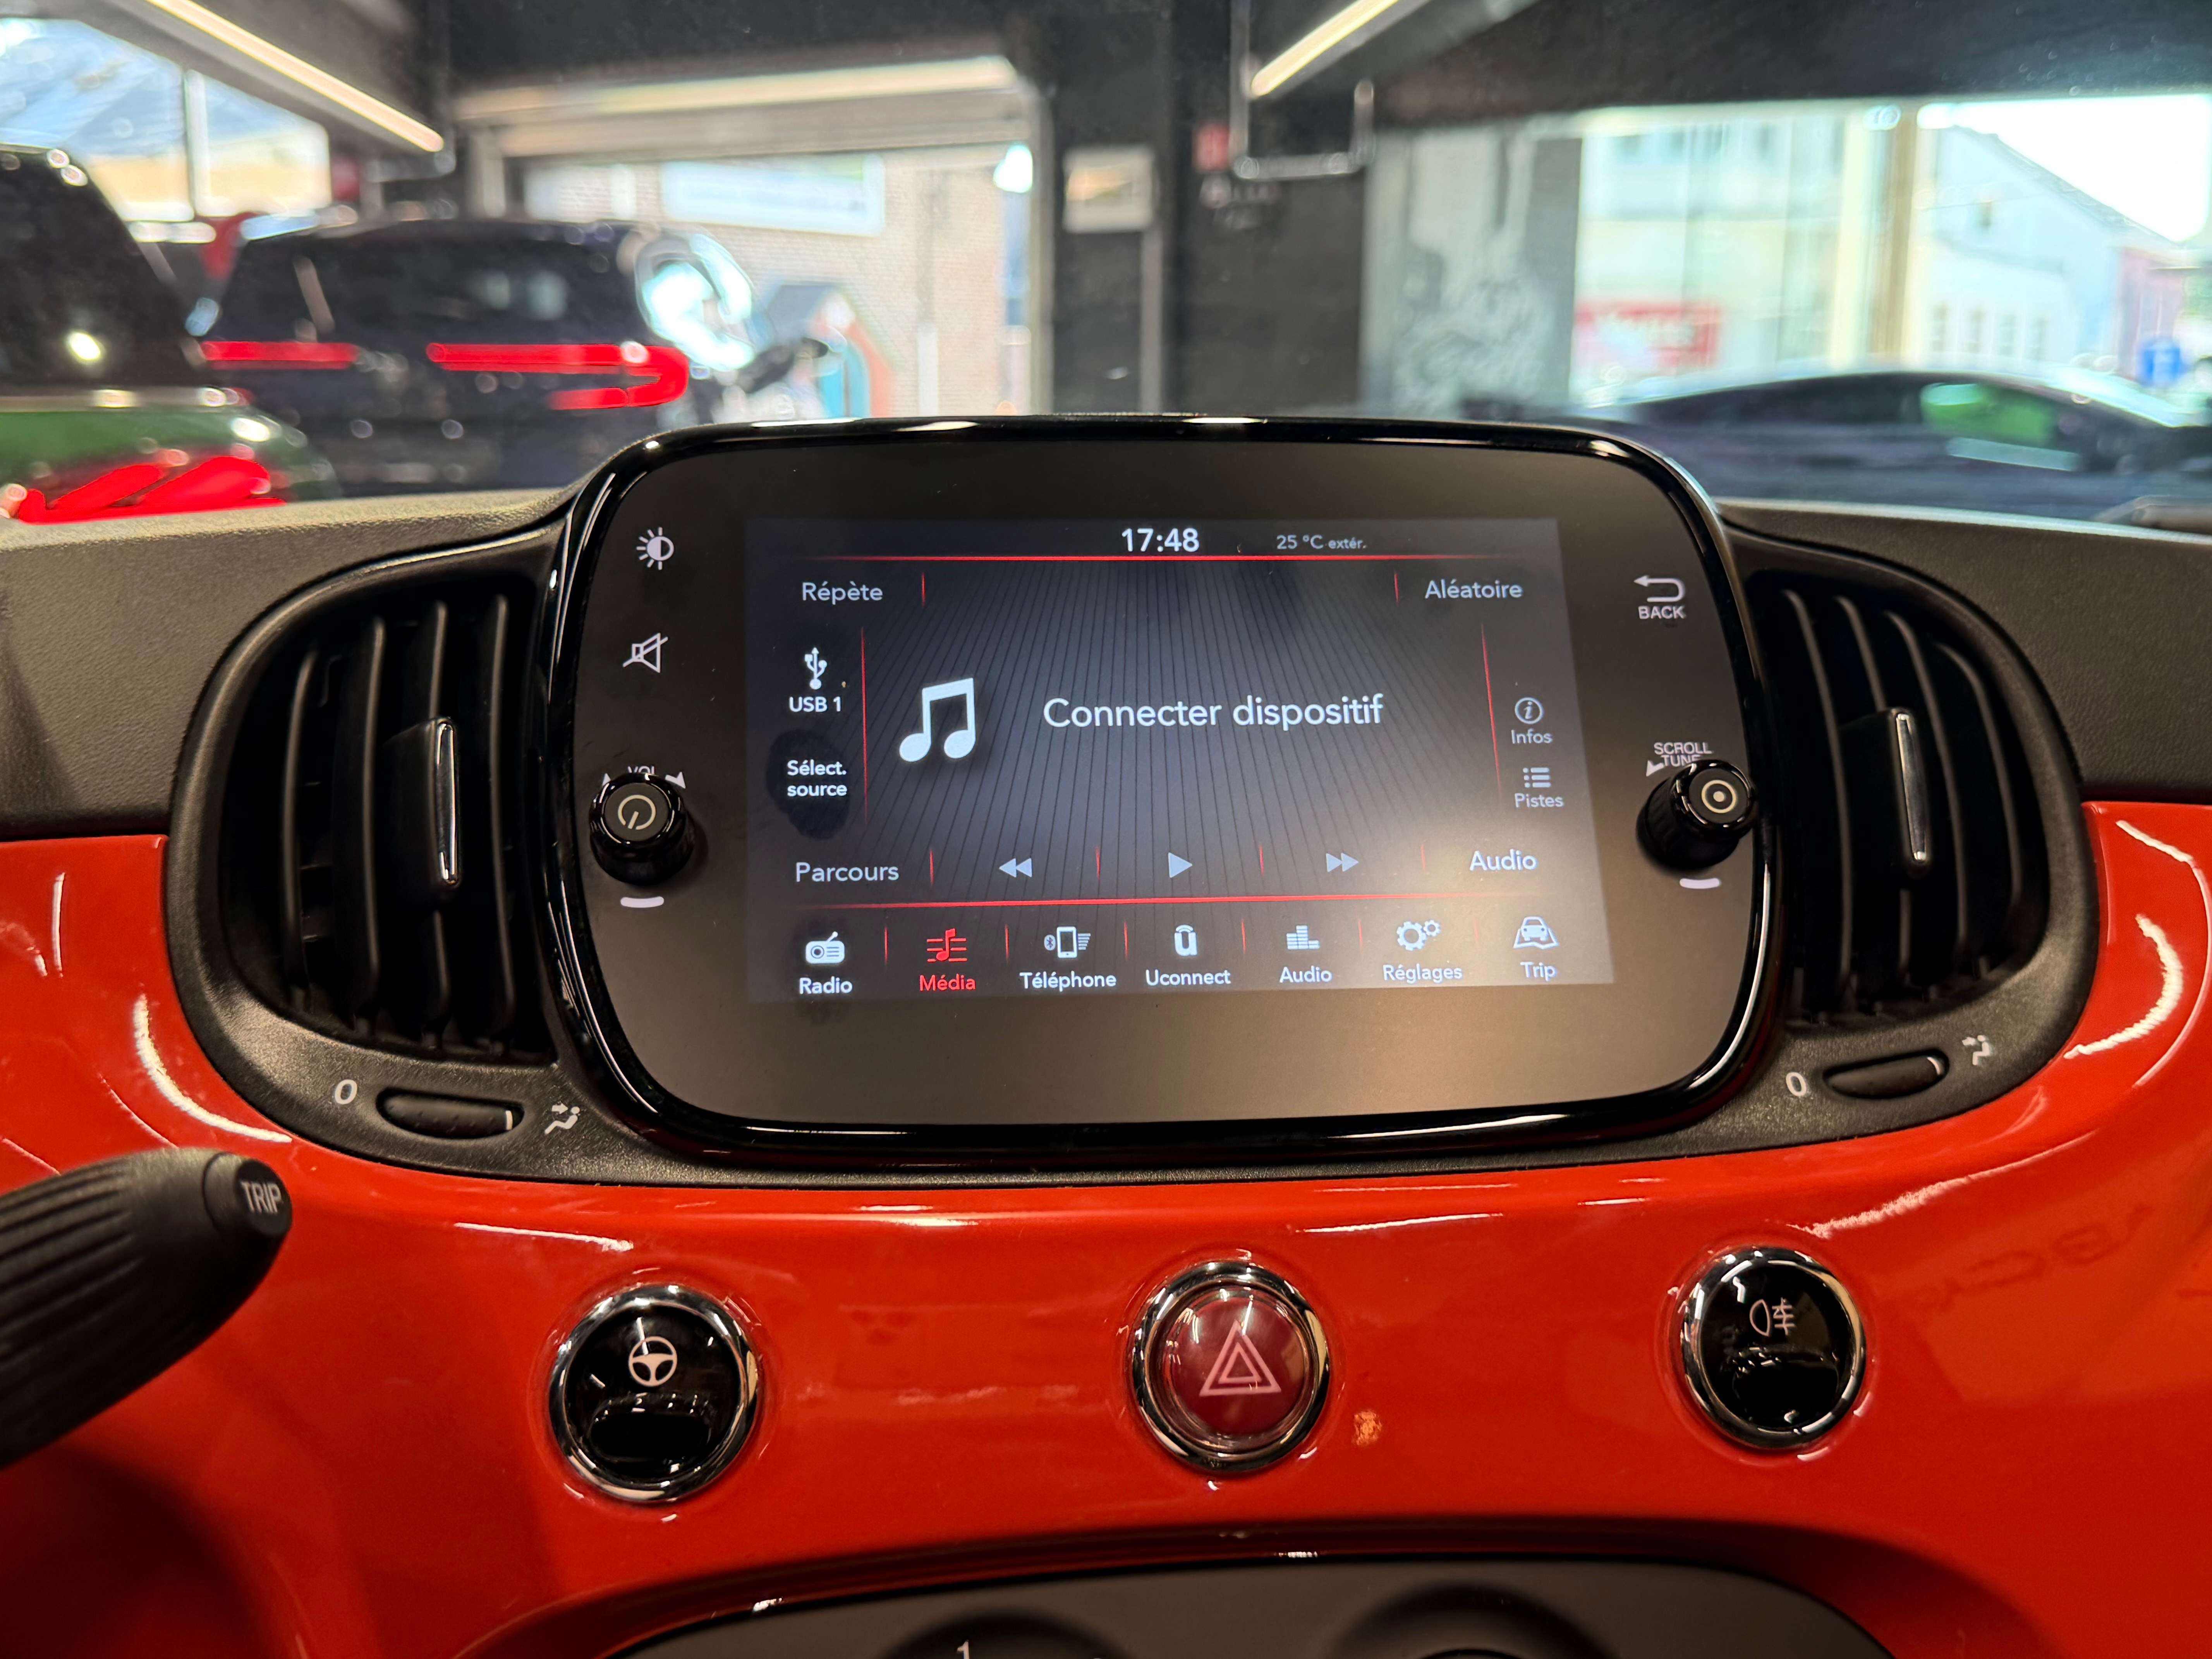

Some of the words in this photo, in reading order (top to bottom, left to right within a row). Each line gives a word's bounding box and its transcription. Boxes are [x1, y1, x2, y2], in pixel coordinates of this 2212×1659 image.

[1121, 528, 1199, 552] 17:48
[1277, 535, 1297, 550] 25
[1328, 537, 1367, 550] extér.
[802, 581, 883, 605] Répète
[1425, 579, 1523, 599] Aléatoire
[1638, 606, 1685, 619] BACK
[789, 696, 828, 713] USB
[833, 696, 841, 712] 1
[1043, 697, 1222, 728] Connecter
[1233, 693, 1384, 732] dispositif
[1511, 728, 1553, 744] Infos
[1654, 742, 1713, 755] SCROLL
[787, 759, 847, 776] Sélect.
[787, 784, 848, 797] source
[1515, 793, 1564, 808] Pistes
[1470, 848, 1537, 871] Audio
[796, 862, 899, 883] Parcours
[1146, 969, 1231, 986] Uconnect
[1279, 965, 1333, 983] Audio
[1383, 963, 1463, 984] Réglages
[1520, 962, 1556, 981] Trip
[799, 975, 853, 994] Radio
[919, 973, 976, 991] Média
[1019, 970, 1117, 992] Téléphone
[240, 1181, 283, 1213] TRIP
